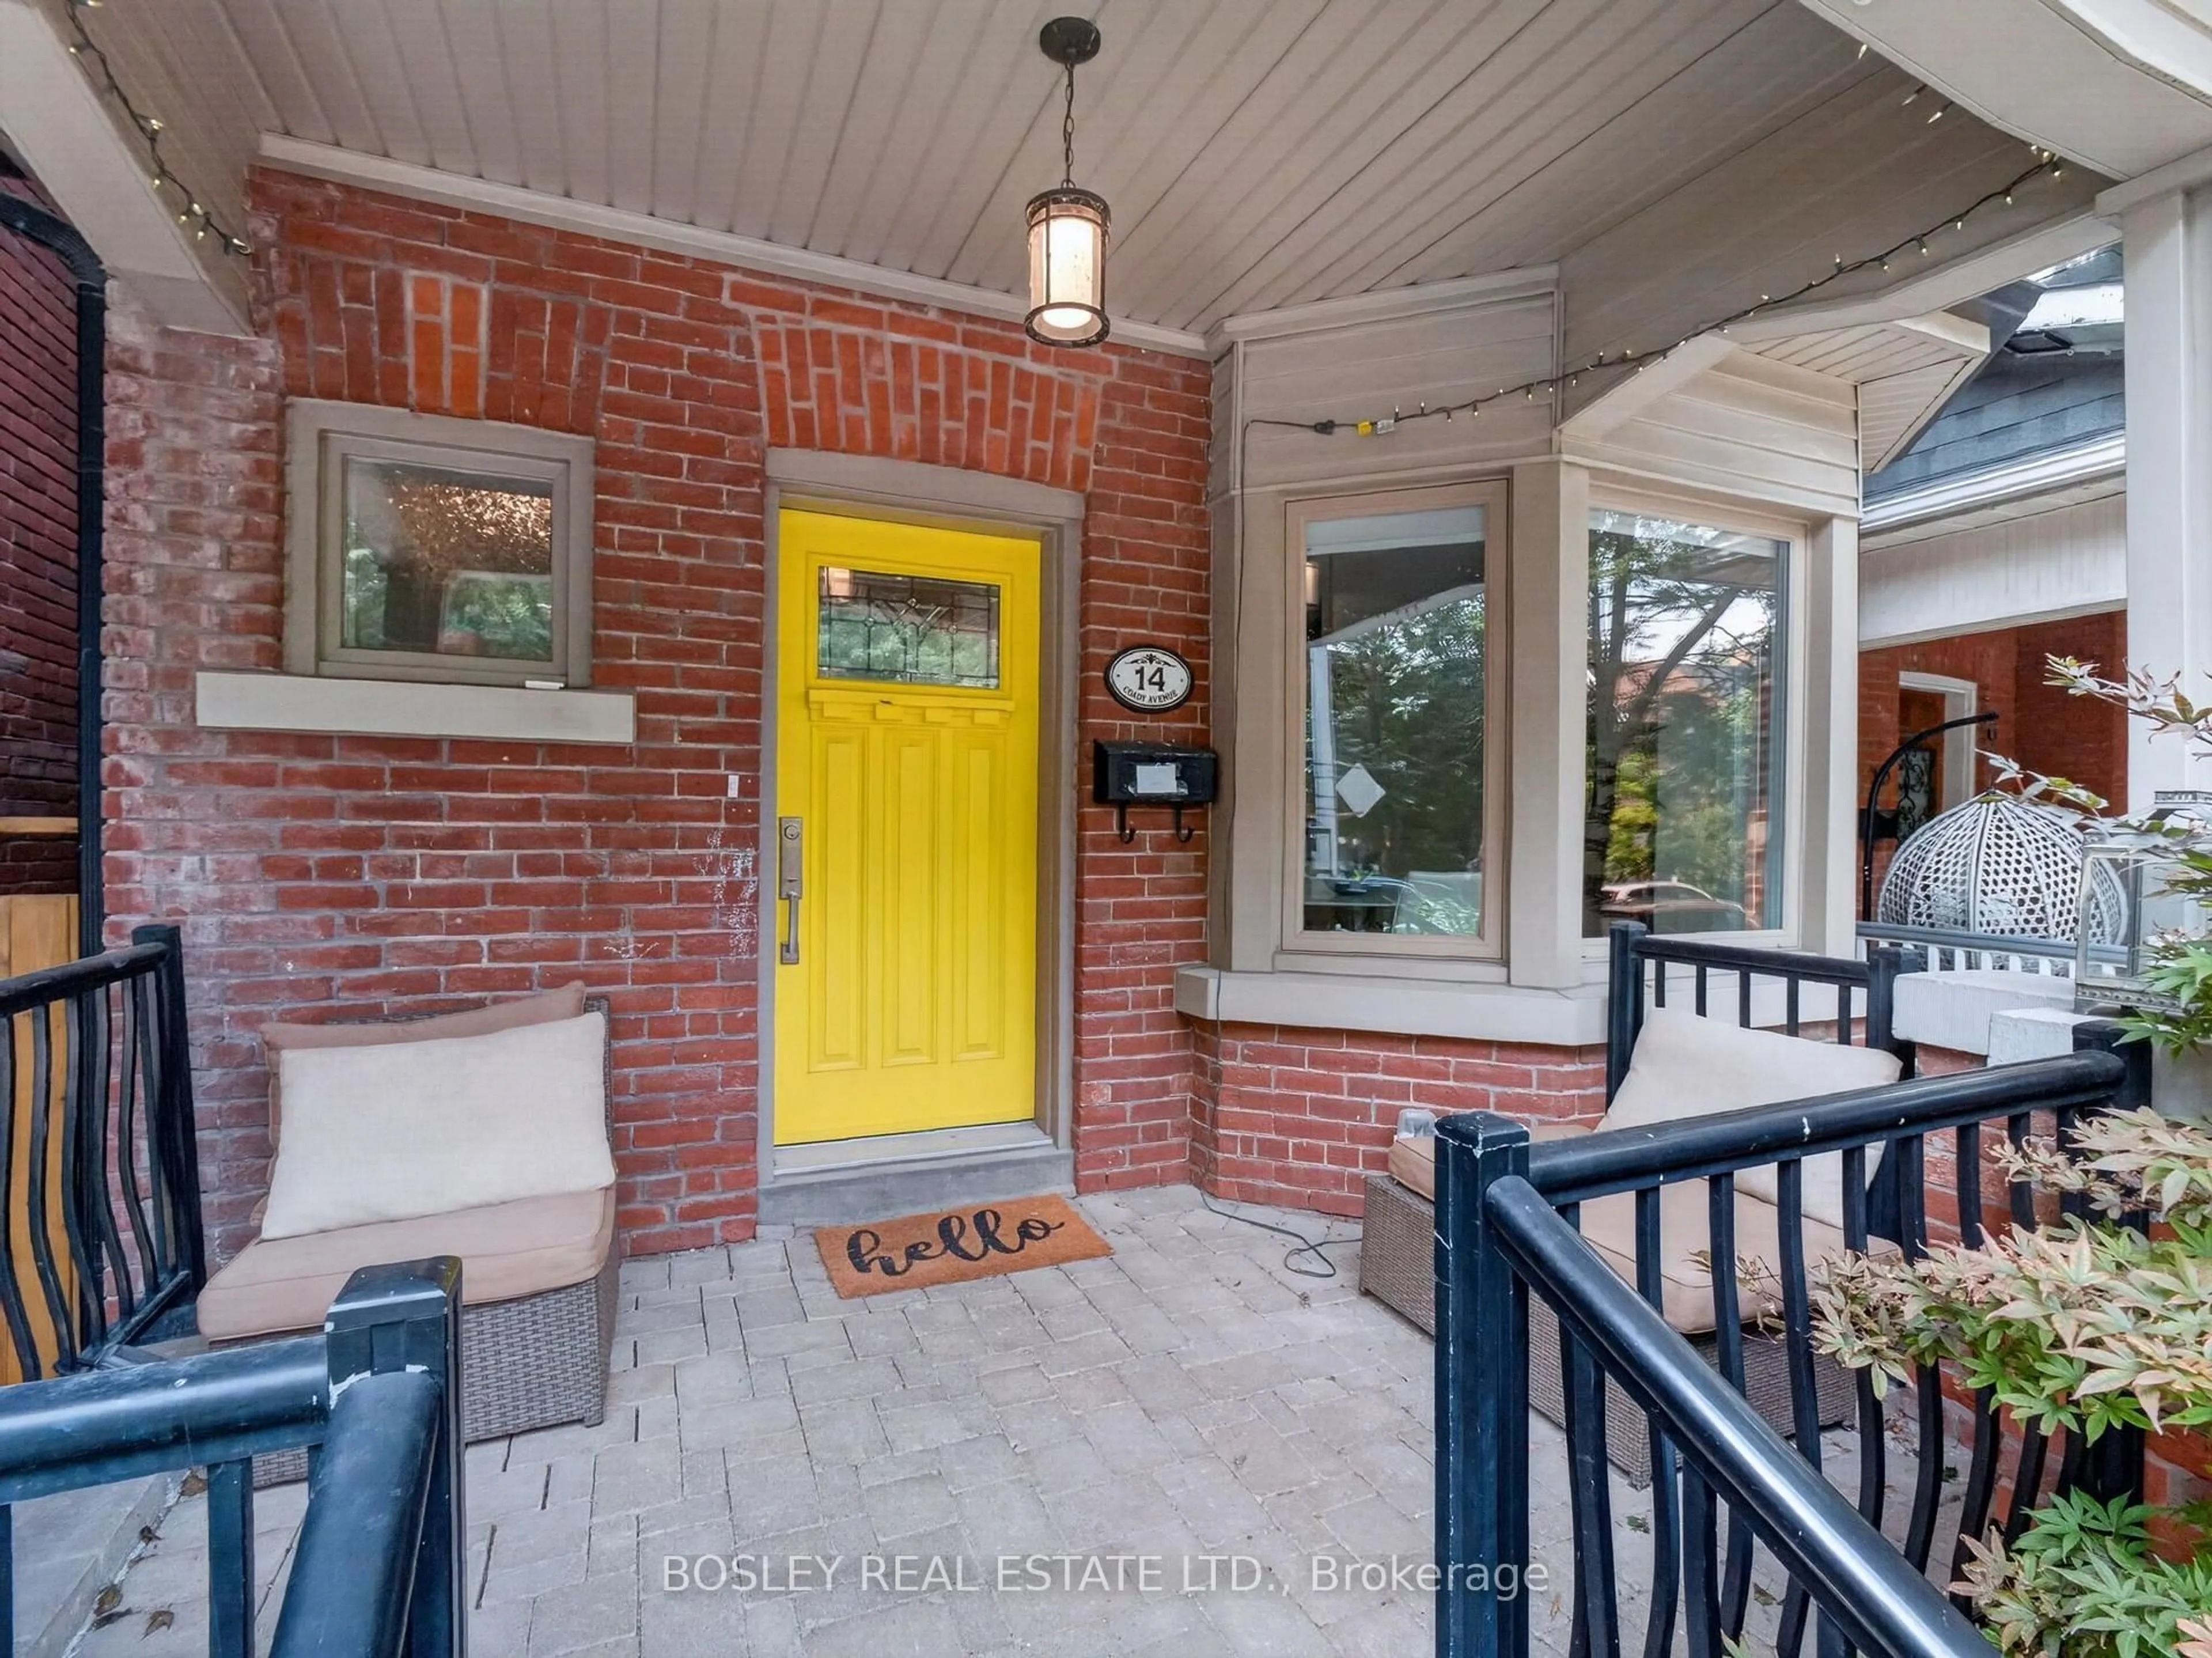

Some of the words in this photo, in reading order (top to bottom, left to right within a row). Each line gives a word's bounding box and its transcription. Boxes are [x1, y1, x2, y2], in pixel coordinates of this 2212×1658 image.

[1135, 665, 1165, 692] 14
[1147, 690, 1179, 703] AVENUE
[846, 1209, 1065, 1277] hello
